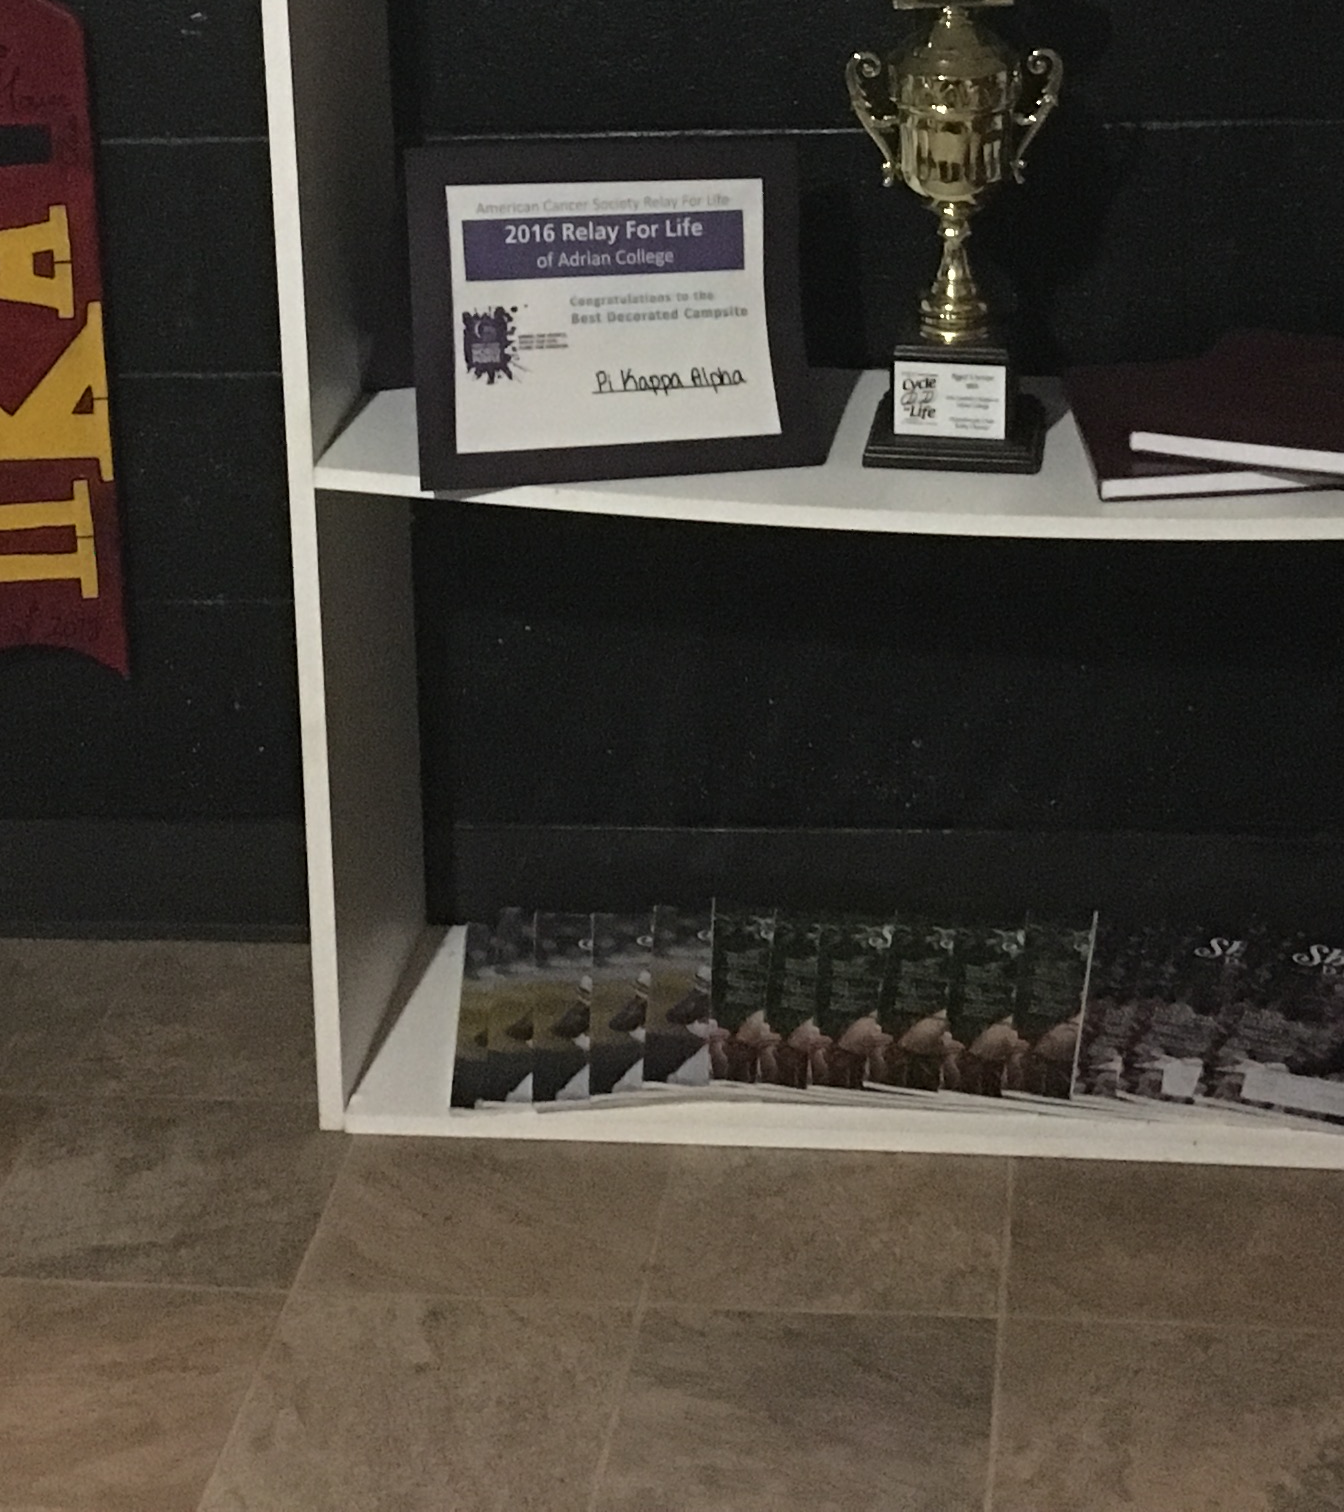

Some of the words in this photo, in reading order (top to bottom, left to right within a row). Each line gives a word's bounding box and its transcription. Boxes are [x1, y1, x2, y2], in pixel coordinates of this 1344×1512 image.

[475, 200, 540, 215] American
[542, 199, 590, 213] Cancer
[592, 197, 640, 214] Society
[643, 196, 679, 211] Relay
[681, 194, 703, 207] For
[706, 193, 731, 207] Life
[504, 224, 556, 245] 2016
[562, 221, 620, 245] Relay
[625, 219, 660, 241] For
[665, 217, 704, 239] Life
[536, 252, 554, 269] of
[558, 250, 612, 268] Adrian
[615, 249, 675, 269] College
[569, 293, 672, 308] Congratulations
[675, 291, 691, 303] to
[693, 290, 715, 302] the
[570, 312, 603, 325] Best
[607, 310, 680, 324] Decorated
[683, 305, 749, 320] Campsite
[594, 369, 613, 392] Pi
[620, 368, 685, 396] Kappa
[689, 366, 748, 394] Alpha
